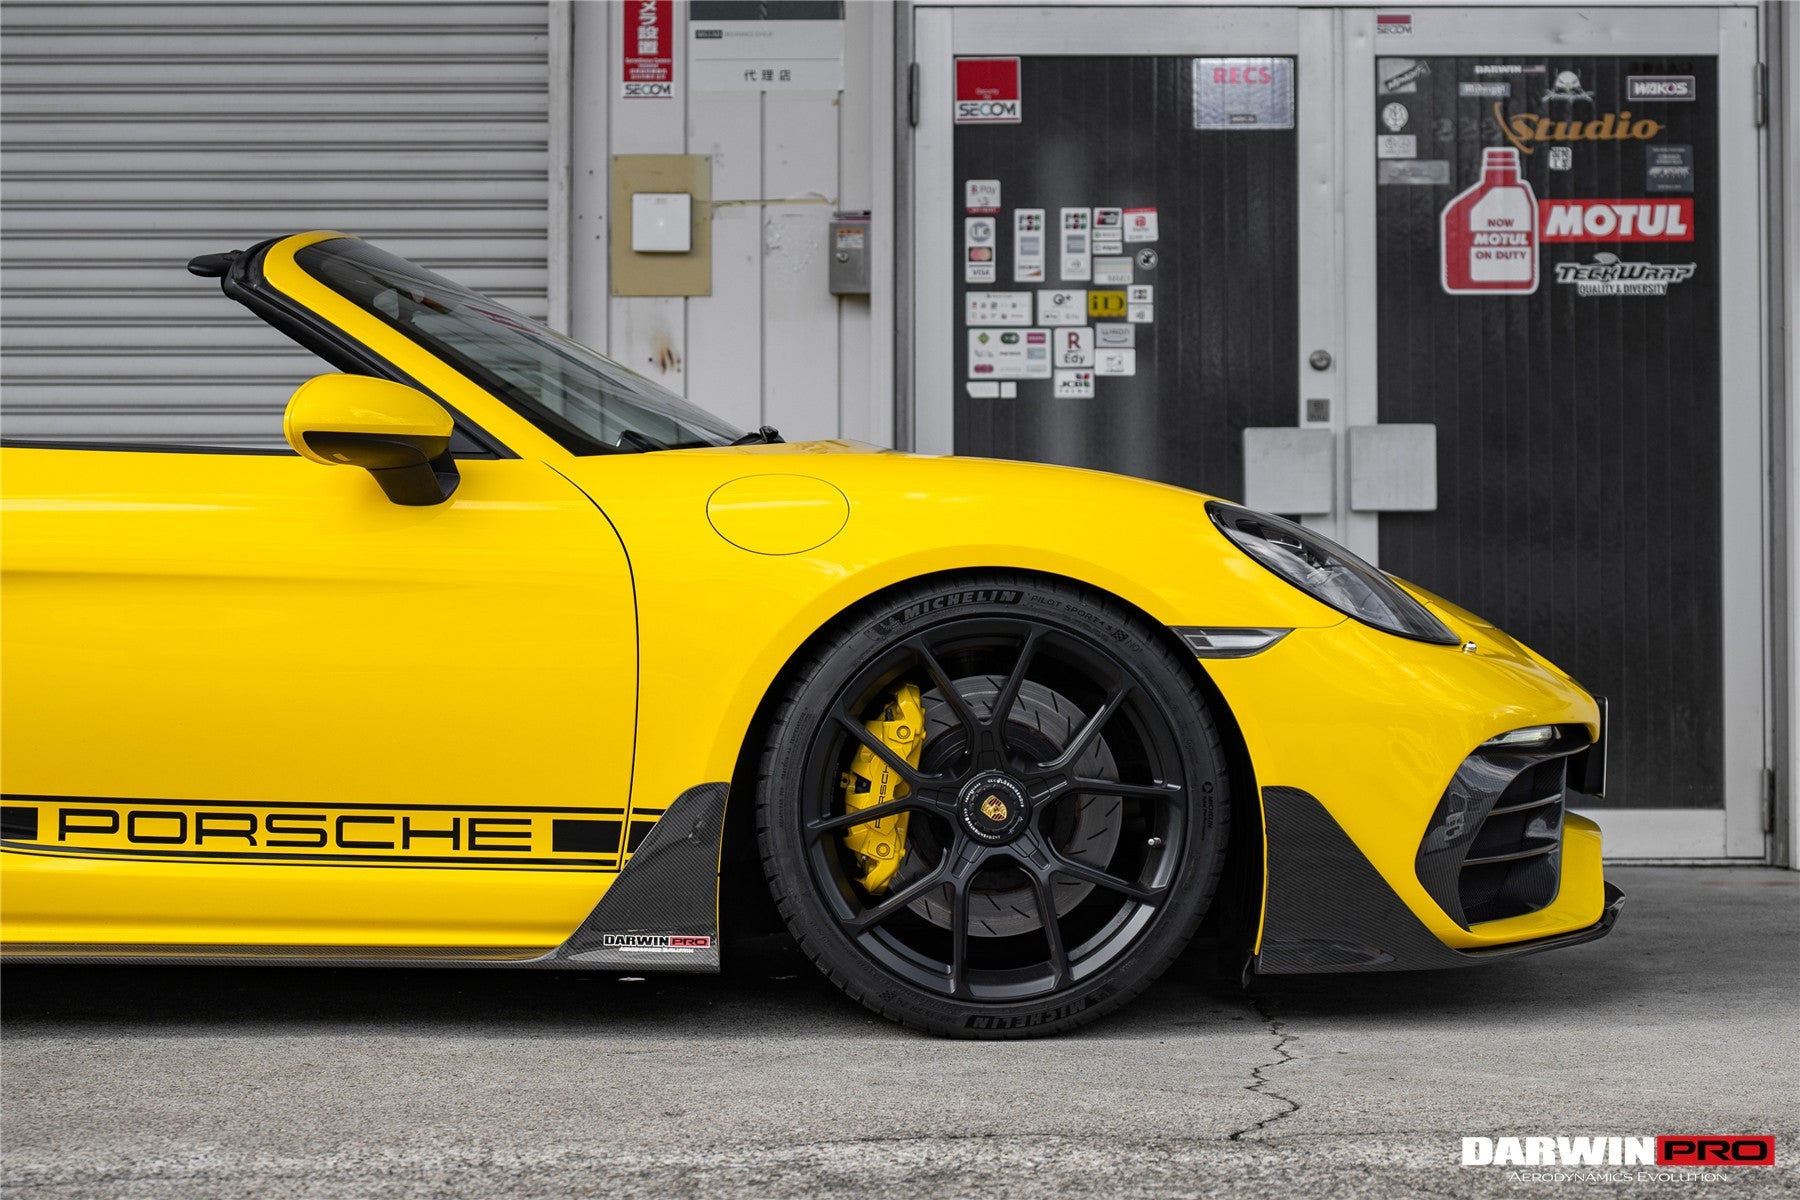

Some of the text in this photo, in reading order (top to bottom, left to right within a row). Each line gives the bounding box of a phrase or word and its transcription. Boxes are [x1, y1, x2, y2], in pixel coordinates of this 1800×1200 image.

[1377, 25, 1412, 34] SECOM
[744, 69, 791, 82] 代理店
[1213, 67, 1272, 84] RECS
[1474, 65, 1522, 74] DARWIN
[625, 83, 671, 95] SECOM
[959, 102, 1017, 117] SECOM
[1502, 109, 1664, 147] Studio
[1487, 218, 1514, 228] NOW
[1545, 204, 1688, 236] MOTUL
[1473, 233, 1529, 246] MOTUL
[1475, 250, 1527, 261] ON DUTY
[1067, 332, 1081, 349] R
[1063, 353, 1086, 365] Edy
[902, 589, 1017, 621] MICHELIN
[1029, 593, 1061, 608] PILOT
[1063, 603, 1100, 624] SPORT
[875, 763, 889, 829] PRSCH
[57, 807, 532, 852] PORSCHE
[603, 934, 708, 948] DARWIN PRO
[972, 997, 1087, 1029] MICHELIN
